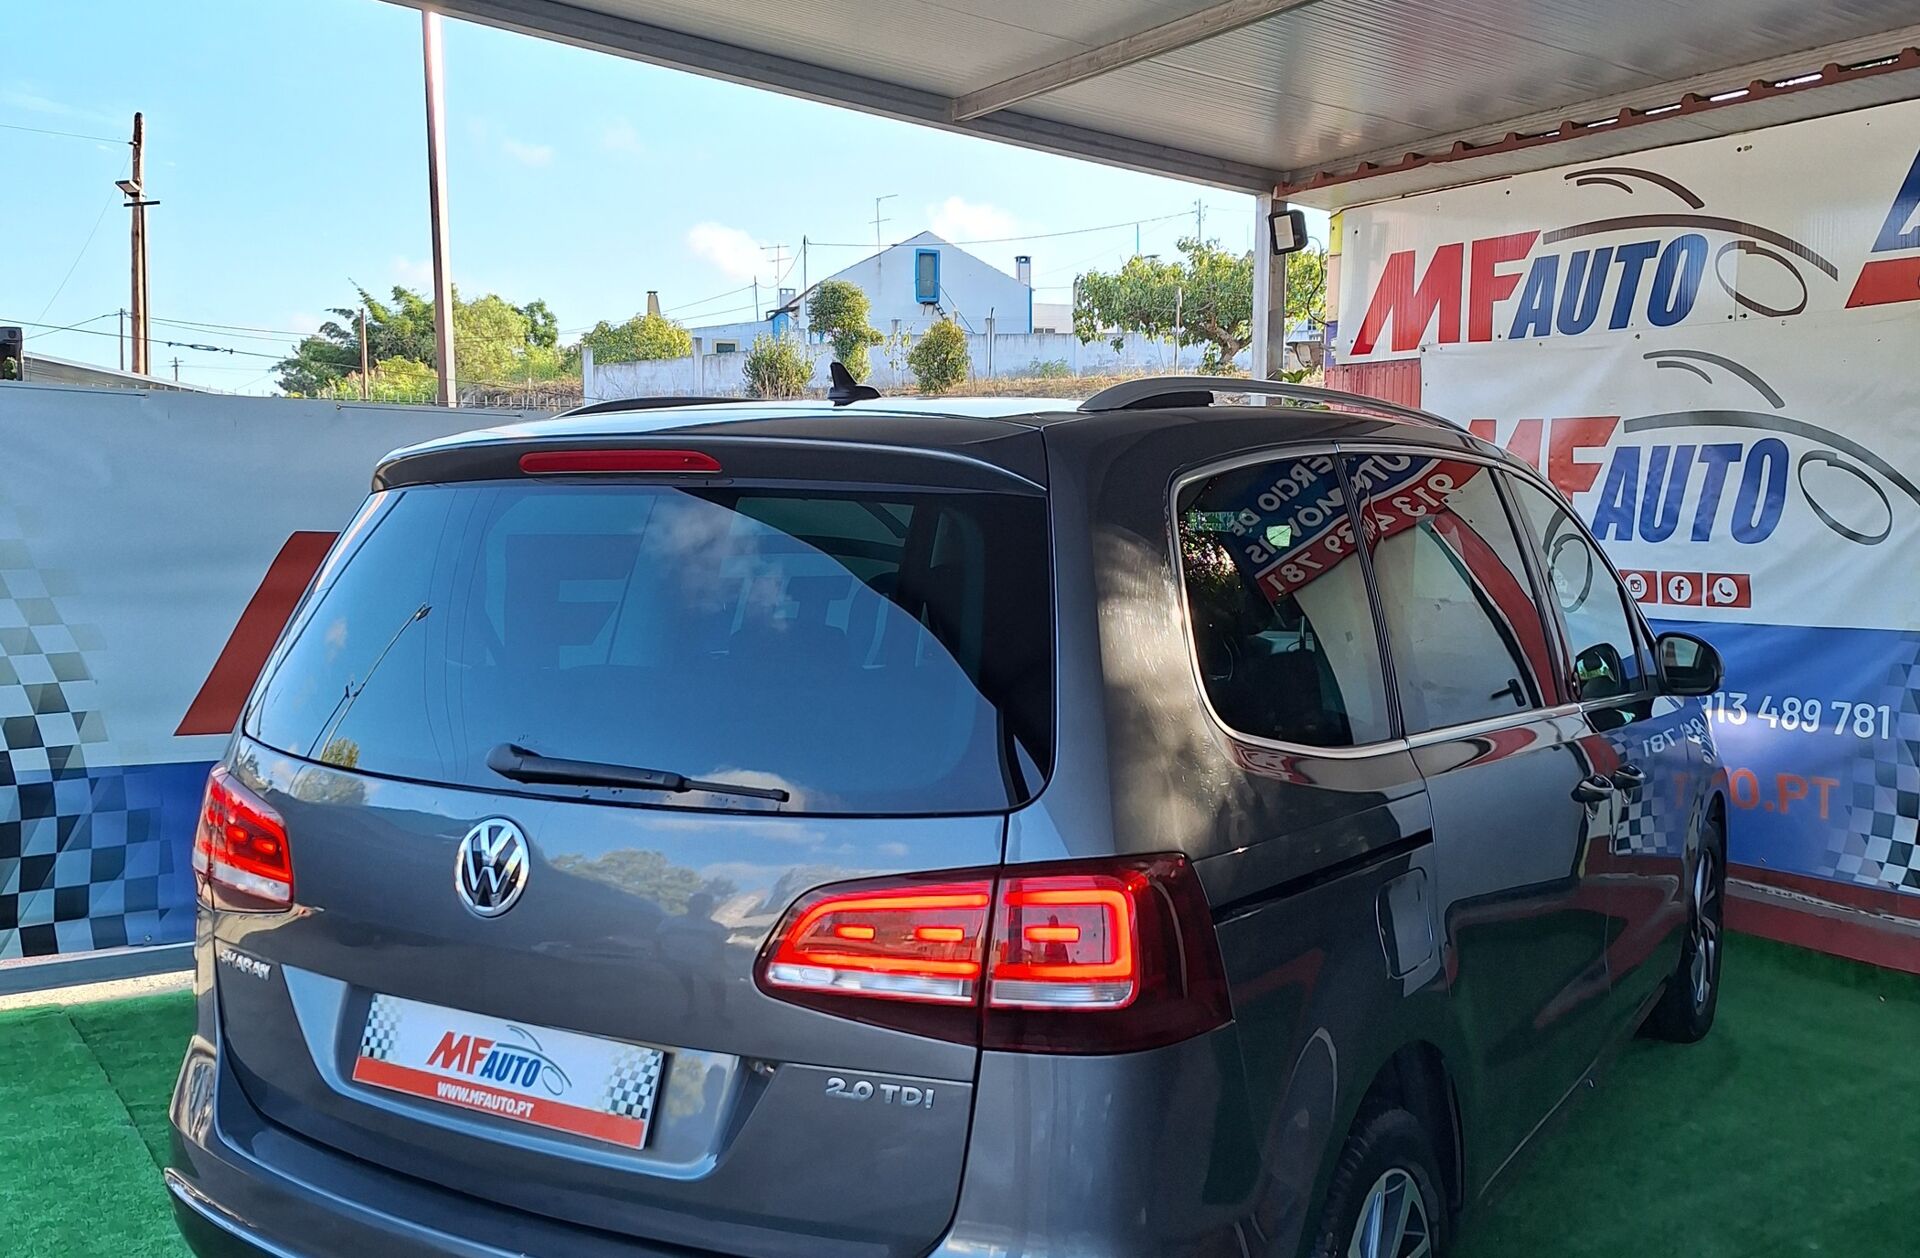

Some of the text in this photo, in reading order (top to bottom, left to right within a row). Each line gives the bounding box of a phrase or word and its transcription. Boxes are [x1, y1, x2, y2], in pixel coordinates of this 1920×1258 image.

[1757, 695, 1822, 733] 489
[1831, 701, 1890, 740] 781
[437, 1081, 534, 1118] WWW.MFAUTO.PT
[825, 1077, 935, 1109] 2.0 TDI
